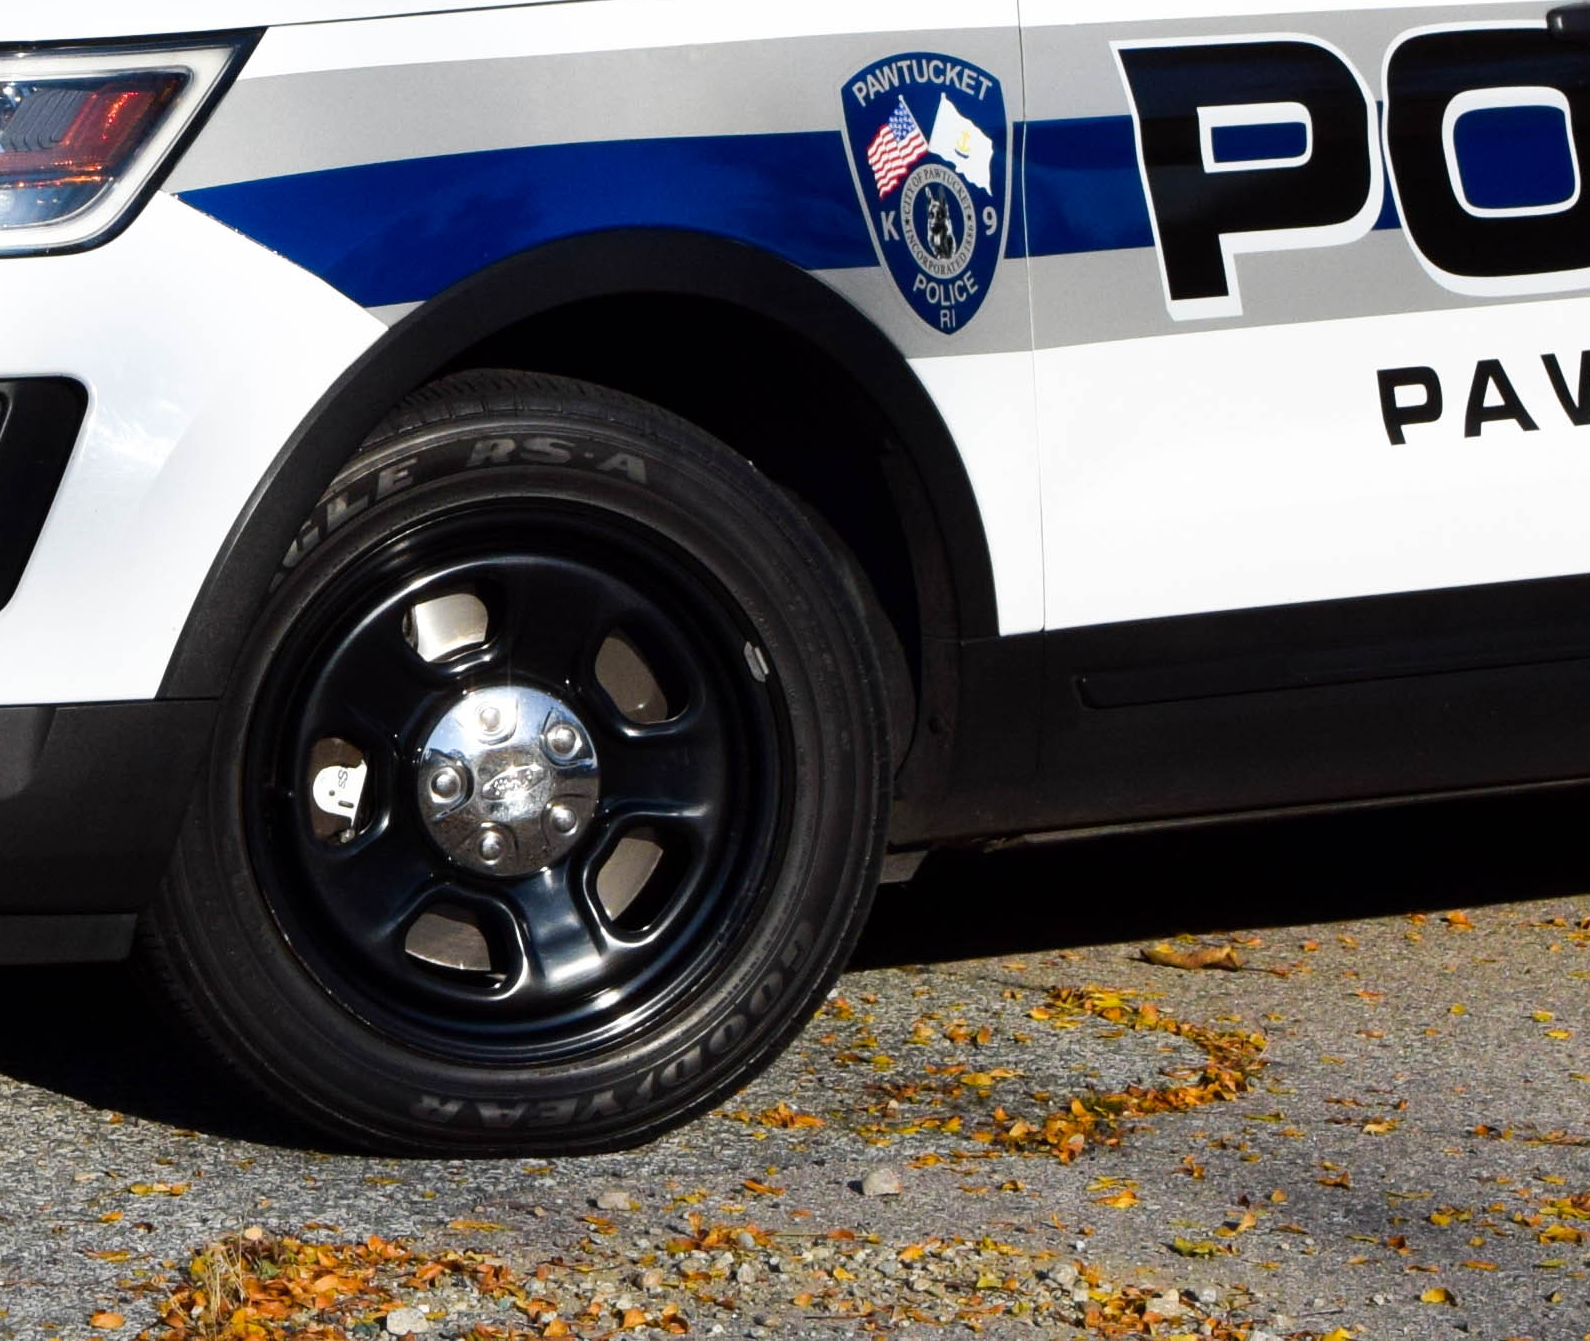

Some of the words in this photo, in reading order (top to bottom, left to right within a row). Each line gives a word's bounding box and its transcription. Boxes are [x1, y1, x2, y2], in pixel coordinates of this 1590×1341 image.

[851, 59, 993, 107] PAWTUCKET
[923, 168, 972, 210] PAWTUCKET
[880, 211, 900, 241] K
[982, 206, 998, 236] 9
[904, 228, 966, 276] INCORPORATED
[913, 270, 979, 307] POLICE
[940, 309, 956, 328] RI
[410, 922, 817, 1128] GOODYEAR
